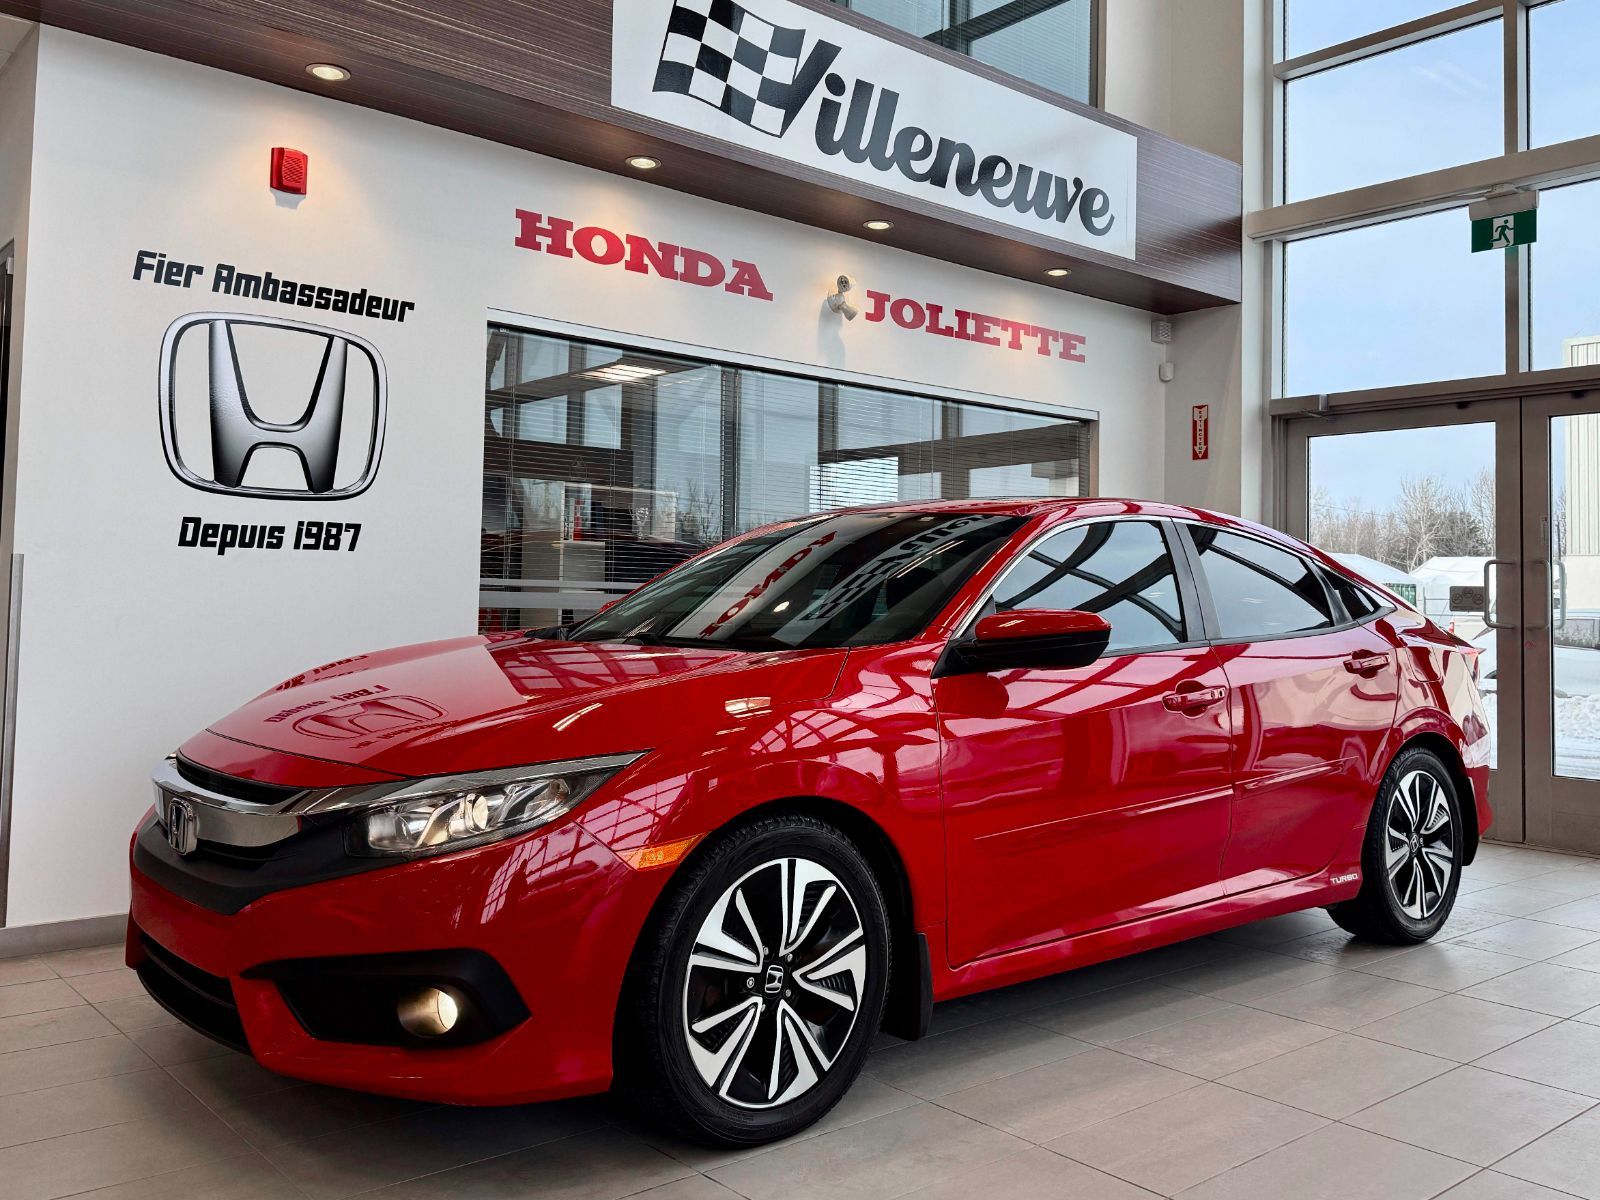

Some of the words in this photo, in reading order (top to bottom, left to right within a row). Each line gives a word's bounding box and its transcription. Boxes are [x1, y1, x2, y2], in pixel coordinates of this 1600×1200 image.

[760, 28, 1115, 236] Villeneuve
[133, 249, 205, 289] Fier
[212, 263, 415, 323] Ambassadeur
[514, 208, 773, 300] HONDA
[865, 289, 1086, 363] JOLIETTE
[178, 516, 286, 556] Depuis
[293, 521, 362, 552] 1987
[1330, 873, 1359, 885] TURBO
